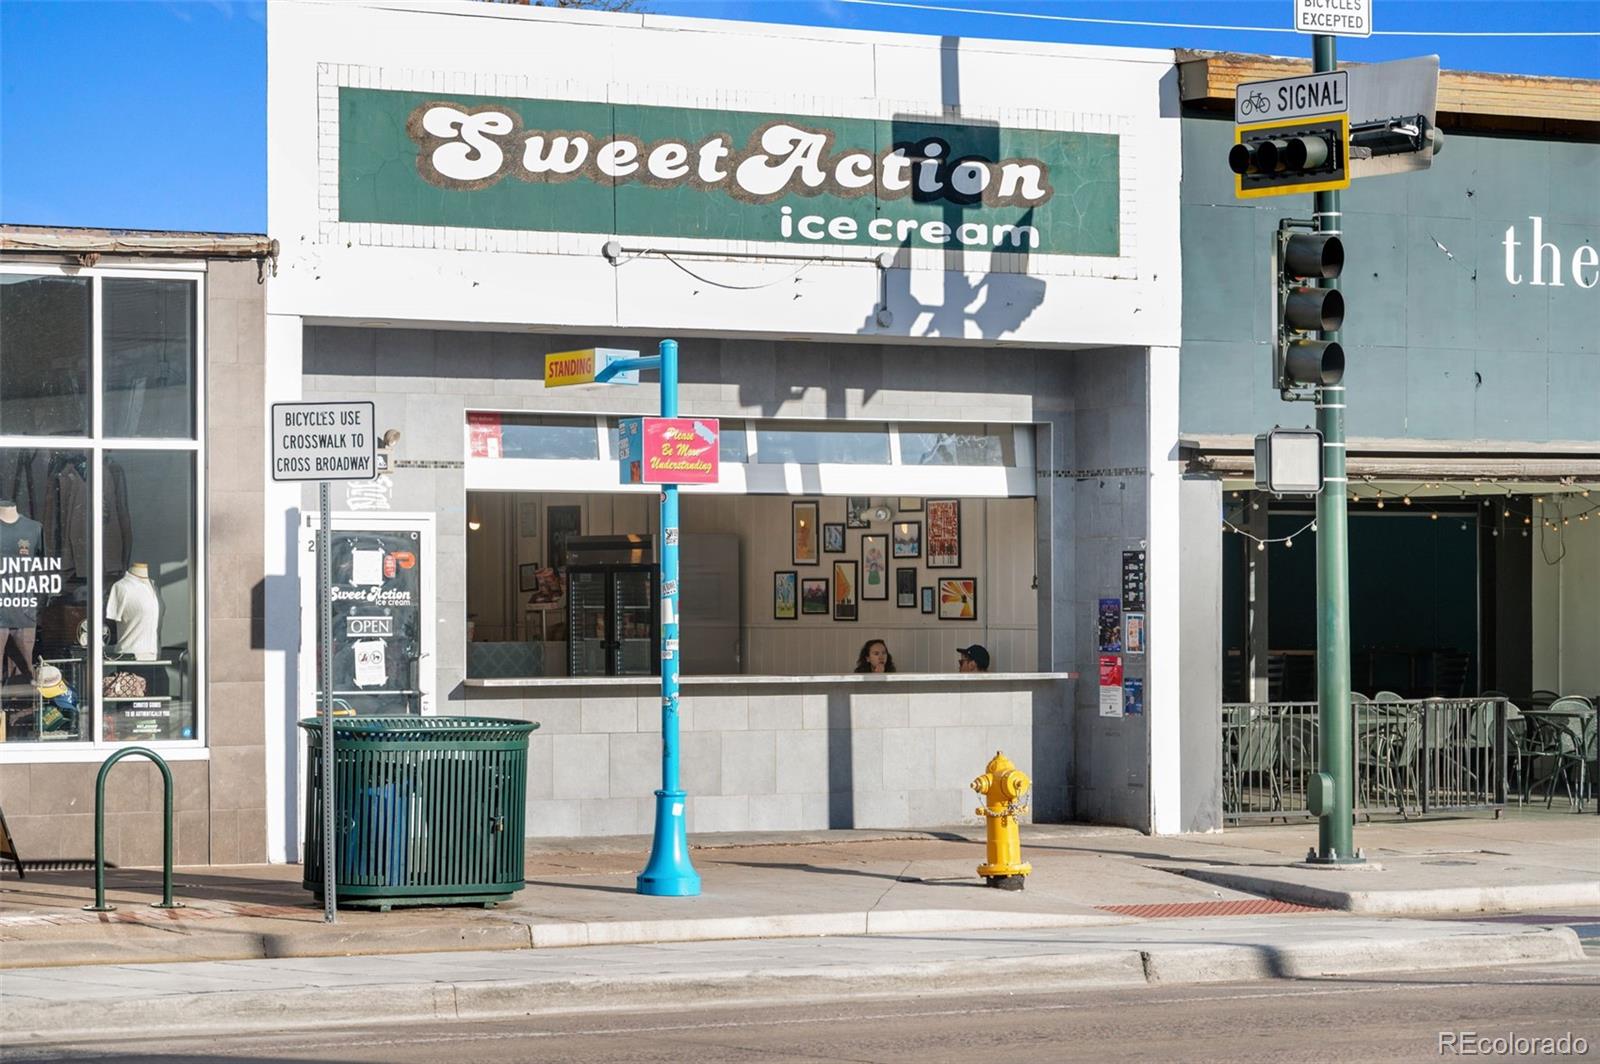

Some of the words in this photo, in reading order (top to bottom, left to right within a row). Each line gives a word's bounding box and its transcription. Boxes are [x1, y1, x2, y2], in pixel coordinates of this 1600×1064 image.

[1304, 0, 1362, 11] BICYCLES
[1302, 12, 1364, 29] EXCEPTED
[1277, 80, 1343, 111] SIGNAL
[422, 106, 728, 183] Sweet
[736, 124, 1046, 200] Action
[780, 205, 858, 241] ice
[867, 213, 1040, 249] cream
[1501, 215, 1600, 289] the
[548, 357, 592, 378] STANDING
[284, 411, 335, 426] BICYCLES
[340, 410, 361, 426] USE
[283, 434, 346, 449] CROSSWALK
[351, 433, 364, 448] TO
[661, 443, 674, 456] Be
[276, 457, 311, 472] CROSS
[316, 456, 370, 472] BROADWAY
[650, 456, 712, 474] Understanding
[1, 574, 62, 594] NDARD
[331, 586, 367, 602] Sweet
[367, 586, 411, 602] Action
[350, 620, 390, 633] OPEN
